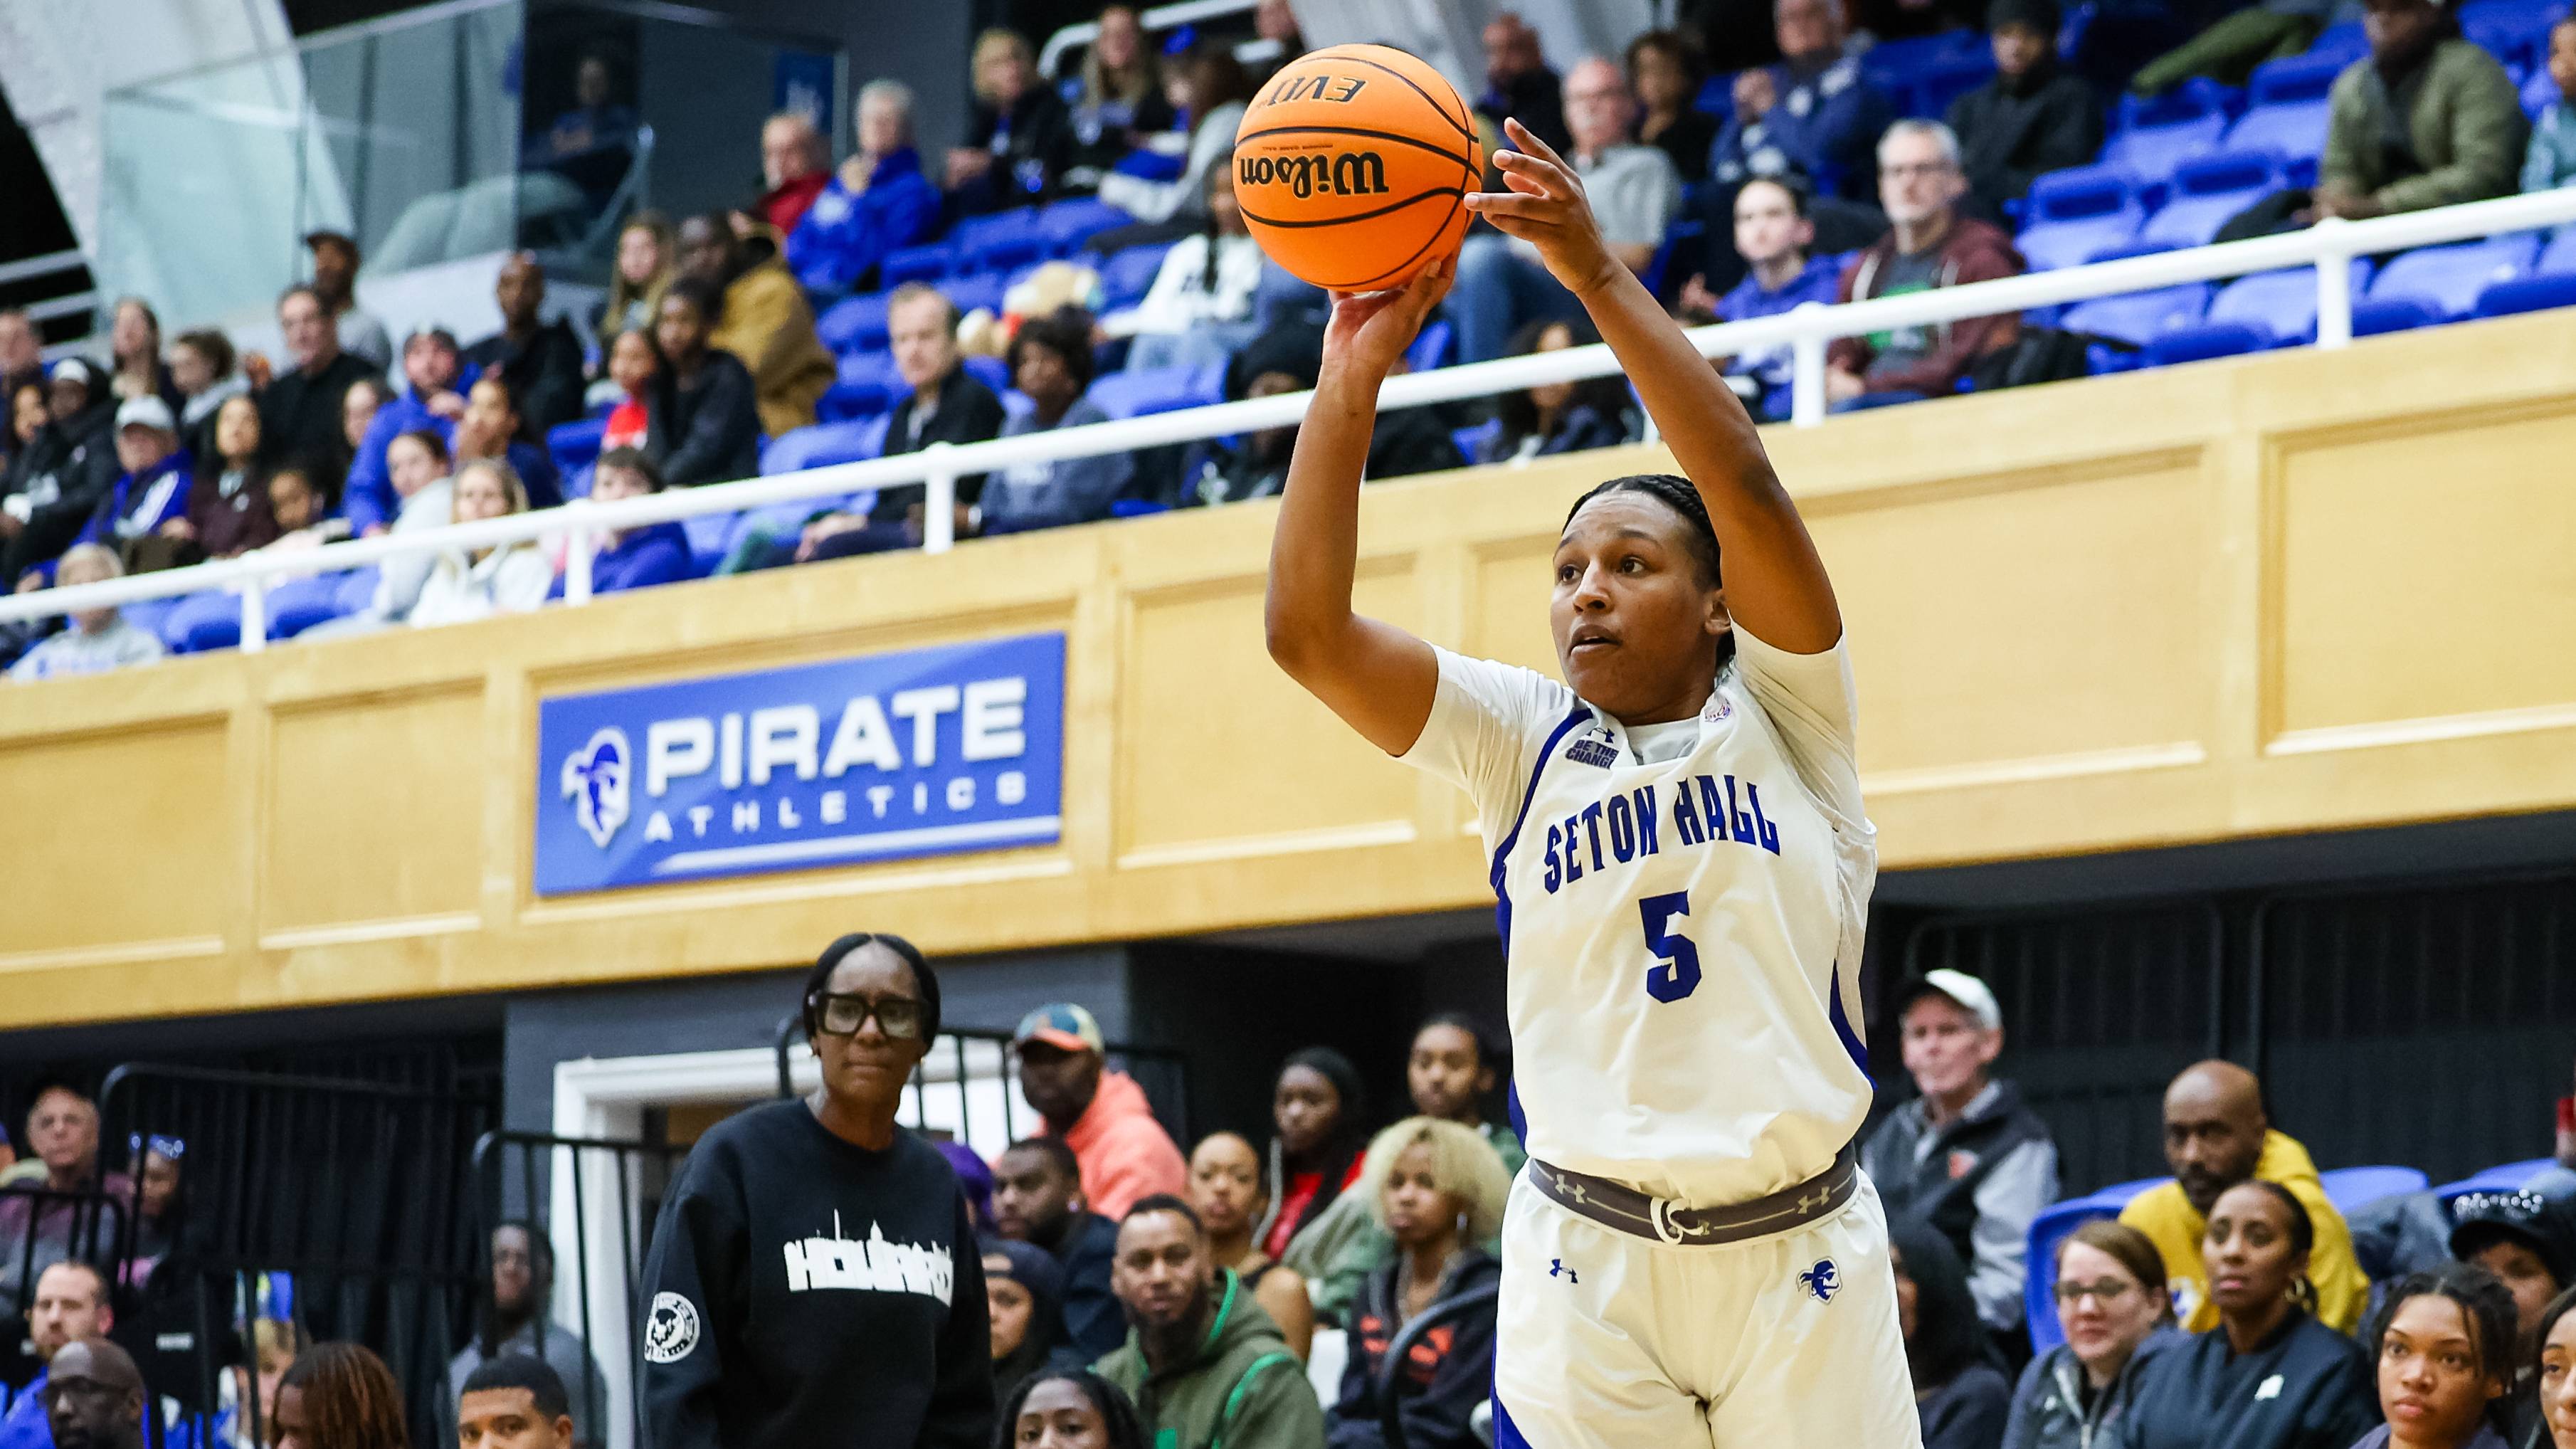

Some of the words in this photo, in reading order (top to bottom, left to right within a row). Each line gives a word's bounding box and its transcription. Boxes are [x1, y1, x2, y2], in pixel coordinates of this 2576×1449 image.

[1240, 152, 1390, 199] Wilson
[646, 677, 1026, 797] PIRATE
[1573, 739, 1593, 752] BE
[1595, 741, 1620, 759] THE
[643, 771, 1025, 843] ATHLETICS
[1543, 784, 1659, 895] SETON
[1673, 774, 1780, 857] HALL
[1638, 889, 1702, 1004] 5
[783, 1233, 954, 1307] HOWARD
